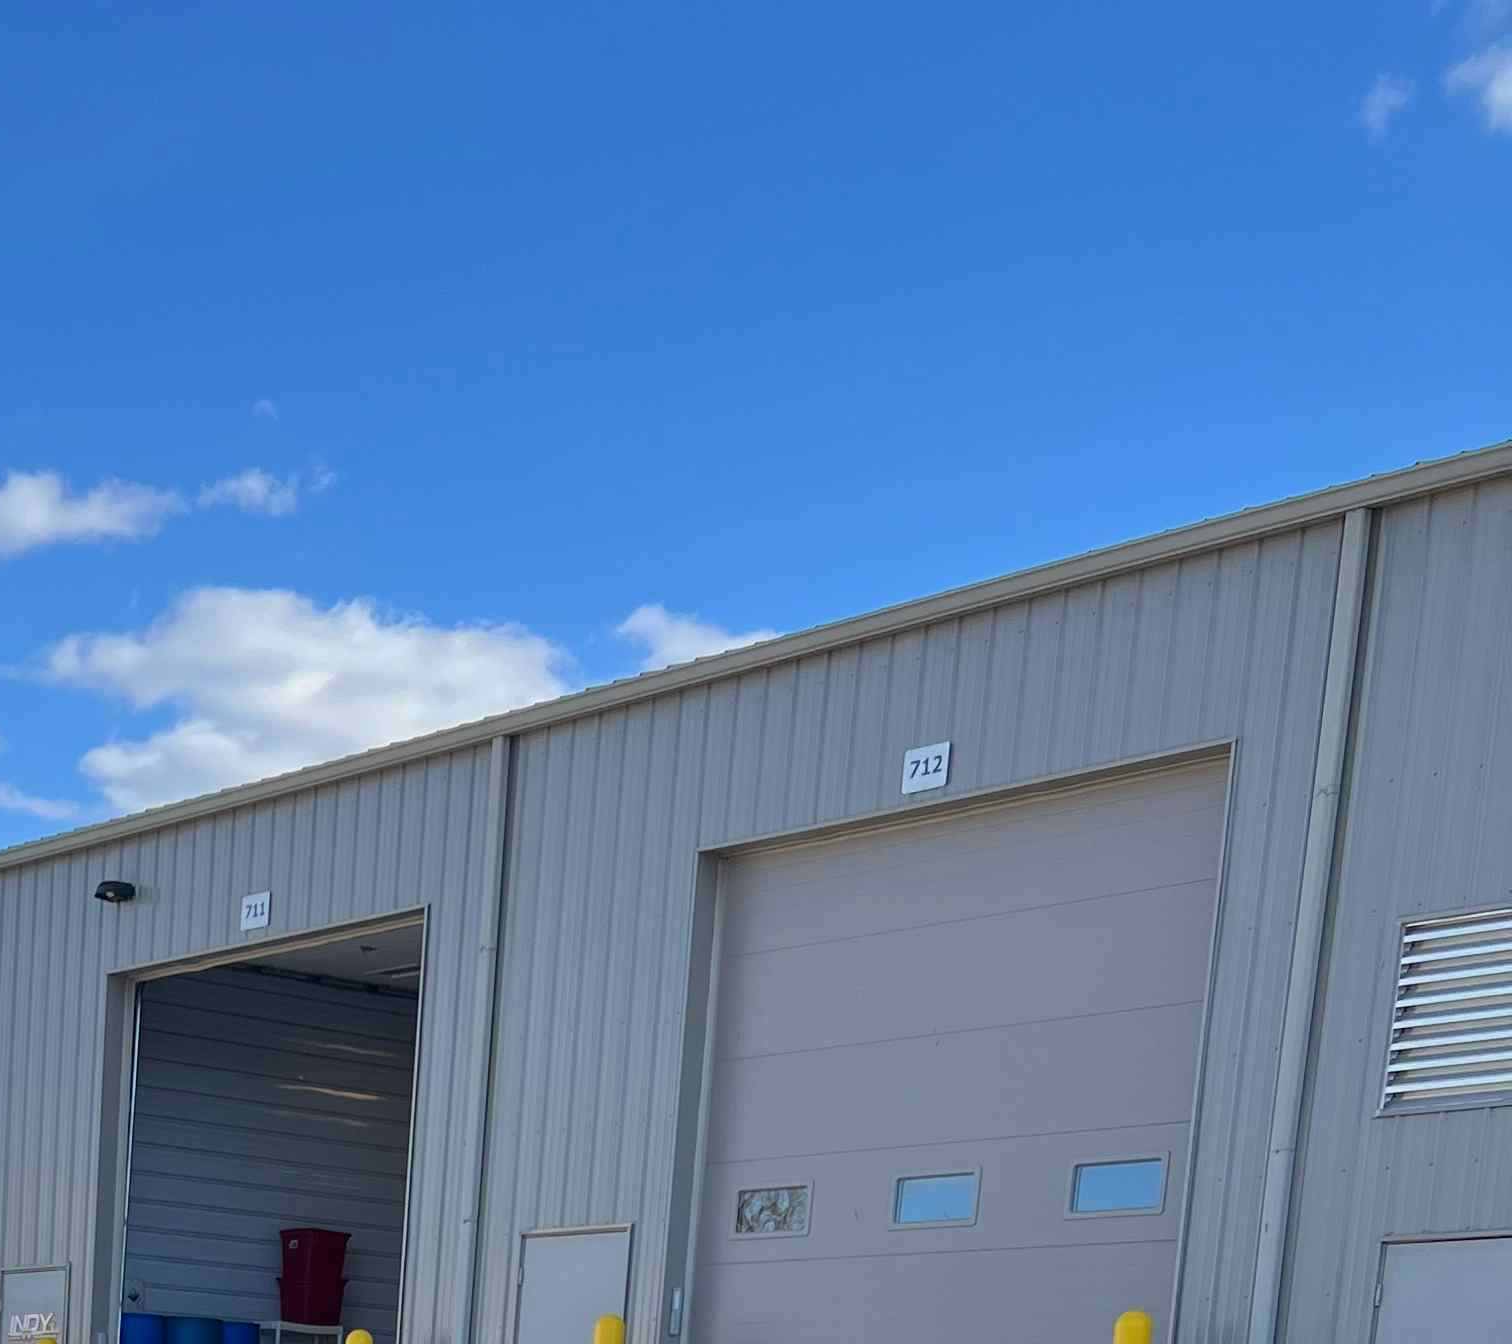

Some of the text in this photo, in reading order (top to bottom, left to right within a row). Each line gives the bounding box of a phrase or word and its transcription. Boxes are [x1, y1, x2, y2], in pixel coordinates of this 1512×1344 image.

[909, 755, 943, 779] 712
[245, 901, 265, 919] 711
[8, 1312, 54, 1336] INDY
